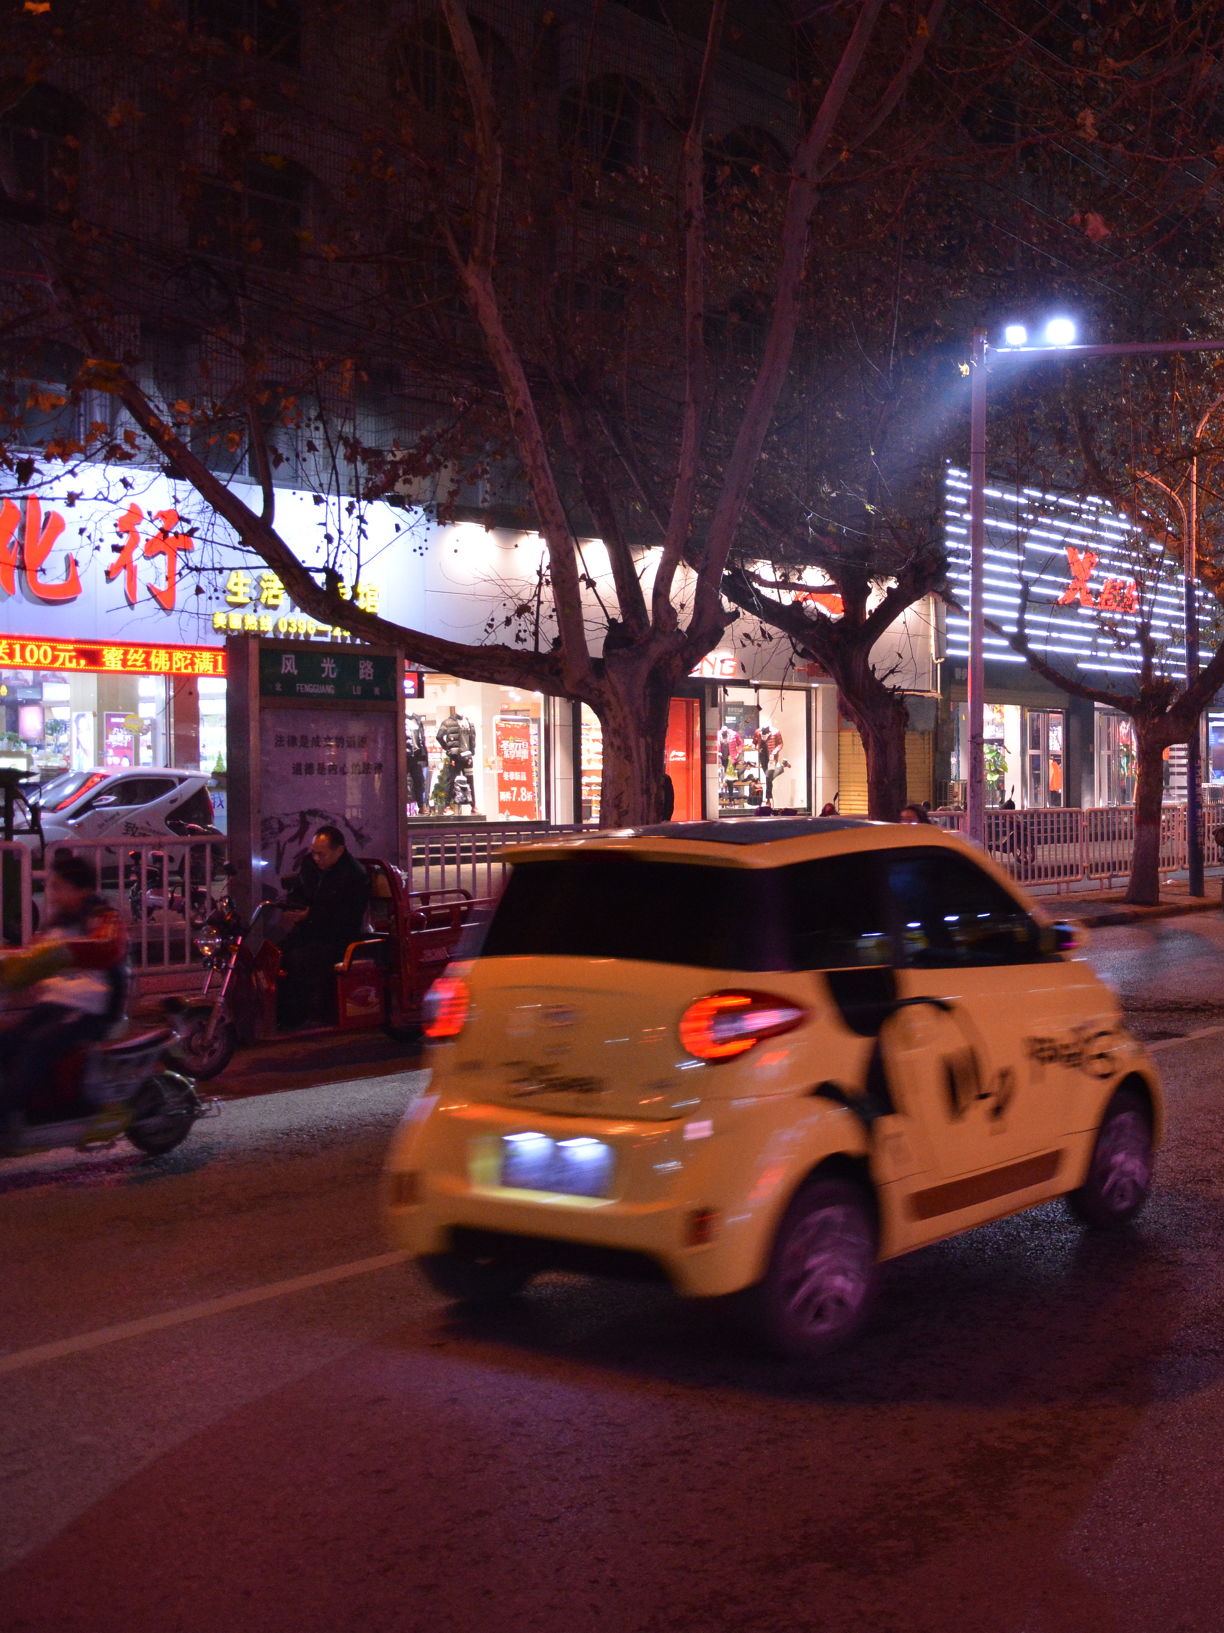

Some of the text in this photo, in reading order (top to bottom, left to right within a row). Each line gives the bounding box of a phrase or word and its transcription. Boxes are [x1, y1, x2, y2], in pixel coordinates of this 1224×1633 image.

[0, 492, 194, 611] 化行
[226, 570, 379, 612] 生活馆
[281, 654, 374, 680] 风光路
[296, 683, 335, 695] FENGGUANG
